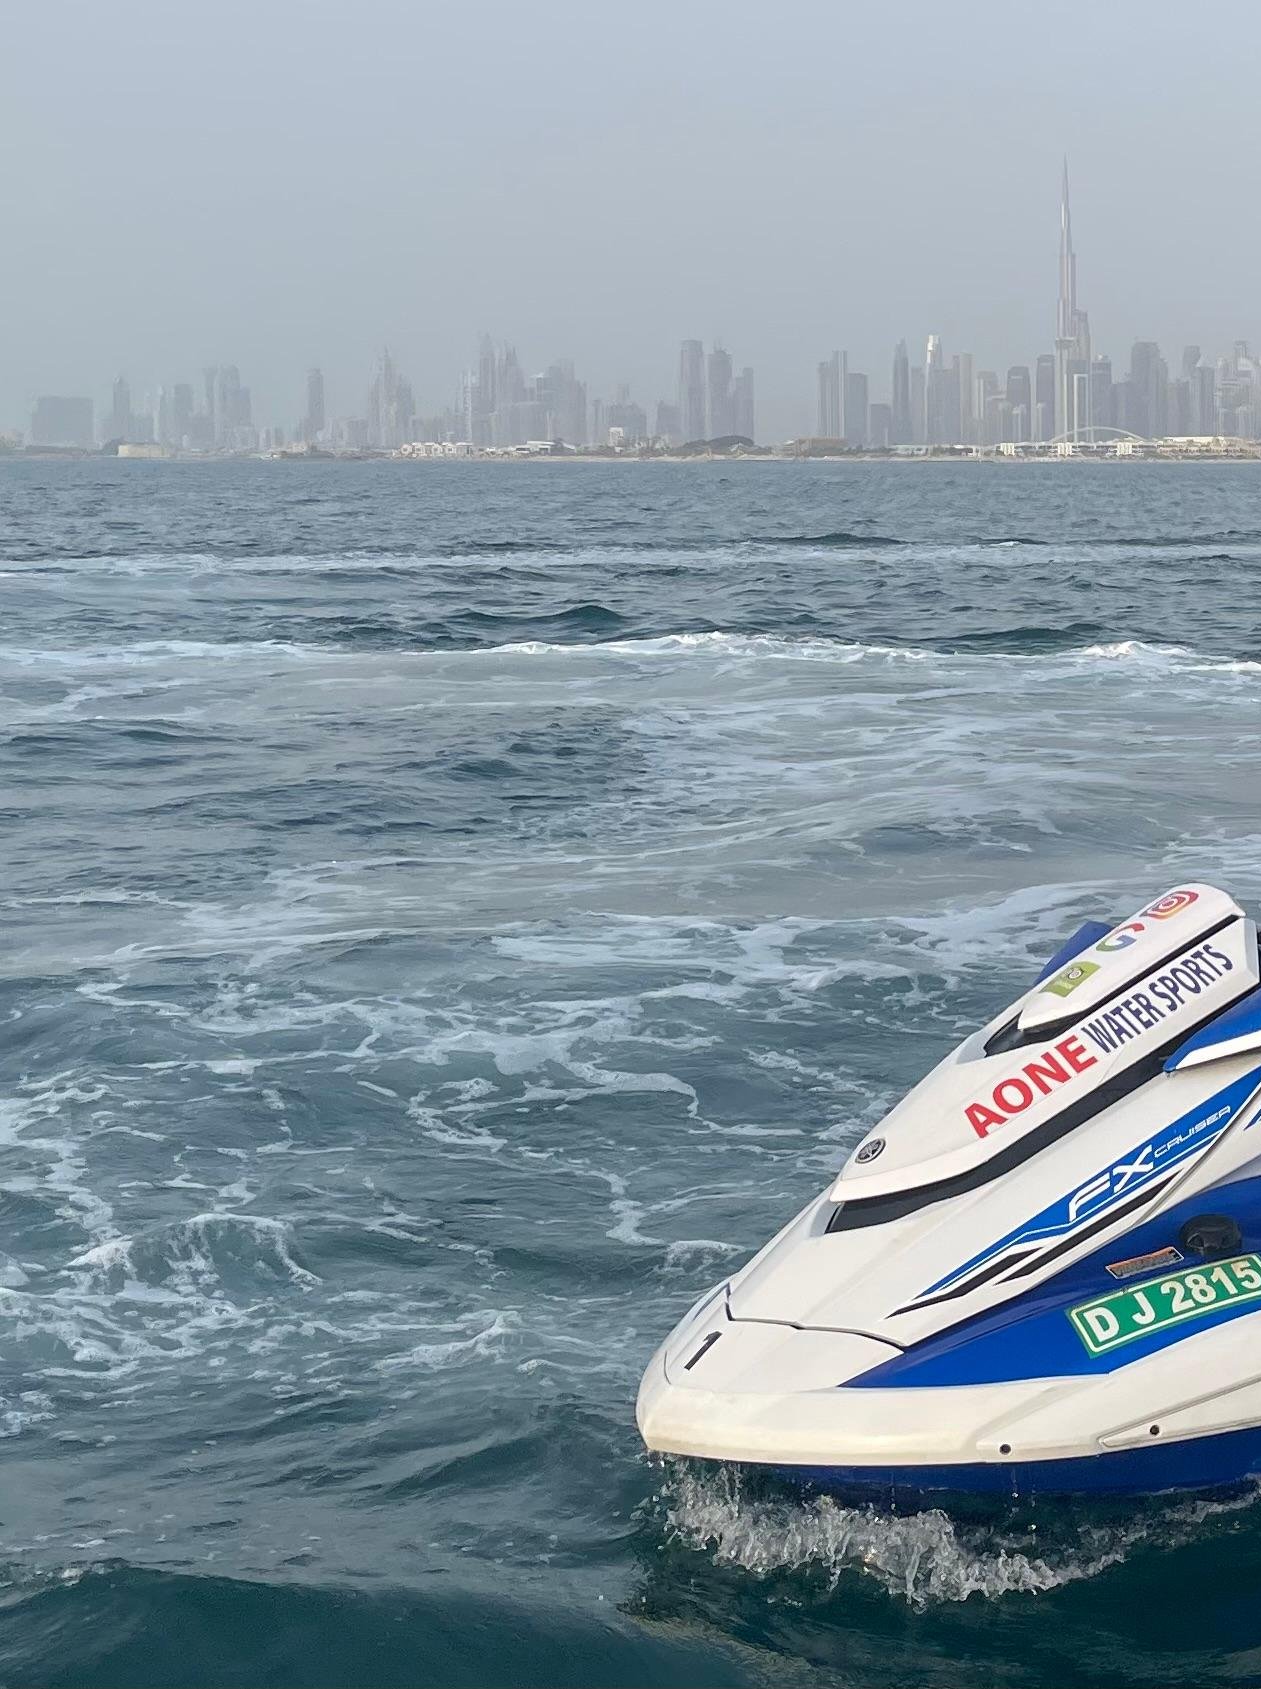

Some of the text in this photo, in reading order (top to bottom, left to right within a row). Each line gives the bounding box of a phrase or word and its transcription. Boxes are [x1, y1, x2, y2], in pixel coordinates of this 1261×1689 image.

[964, 943, 1234, 1138] AONE WATER SPORTS
[1069, 1105, 1231, 1222] FX CRUISER
[1083, 1307, 1120, 1343] D
[1132, 1292, 1156, 1325] J
